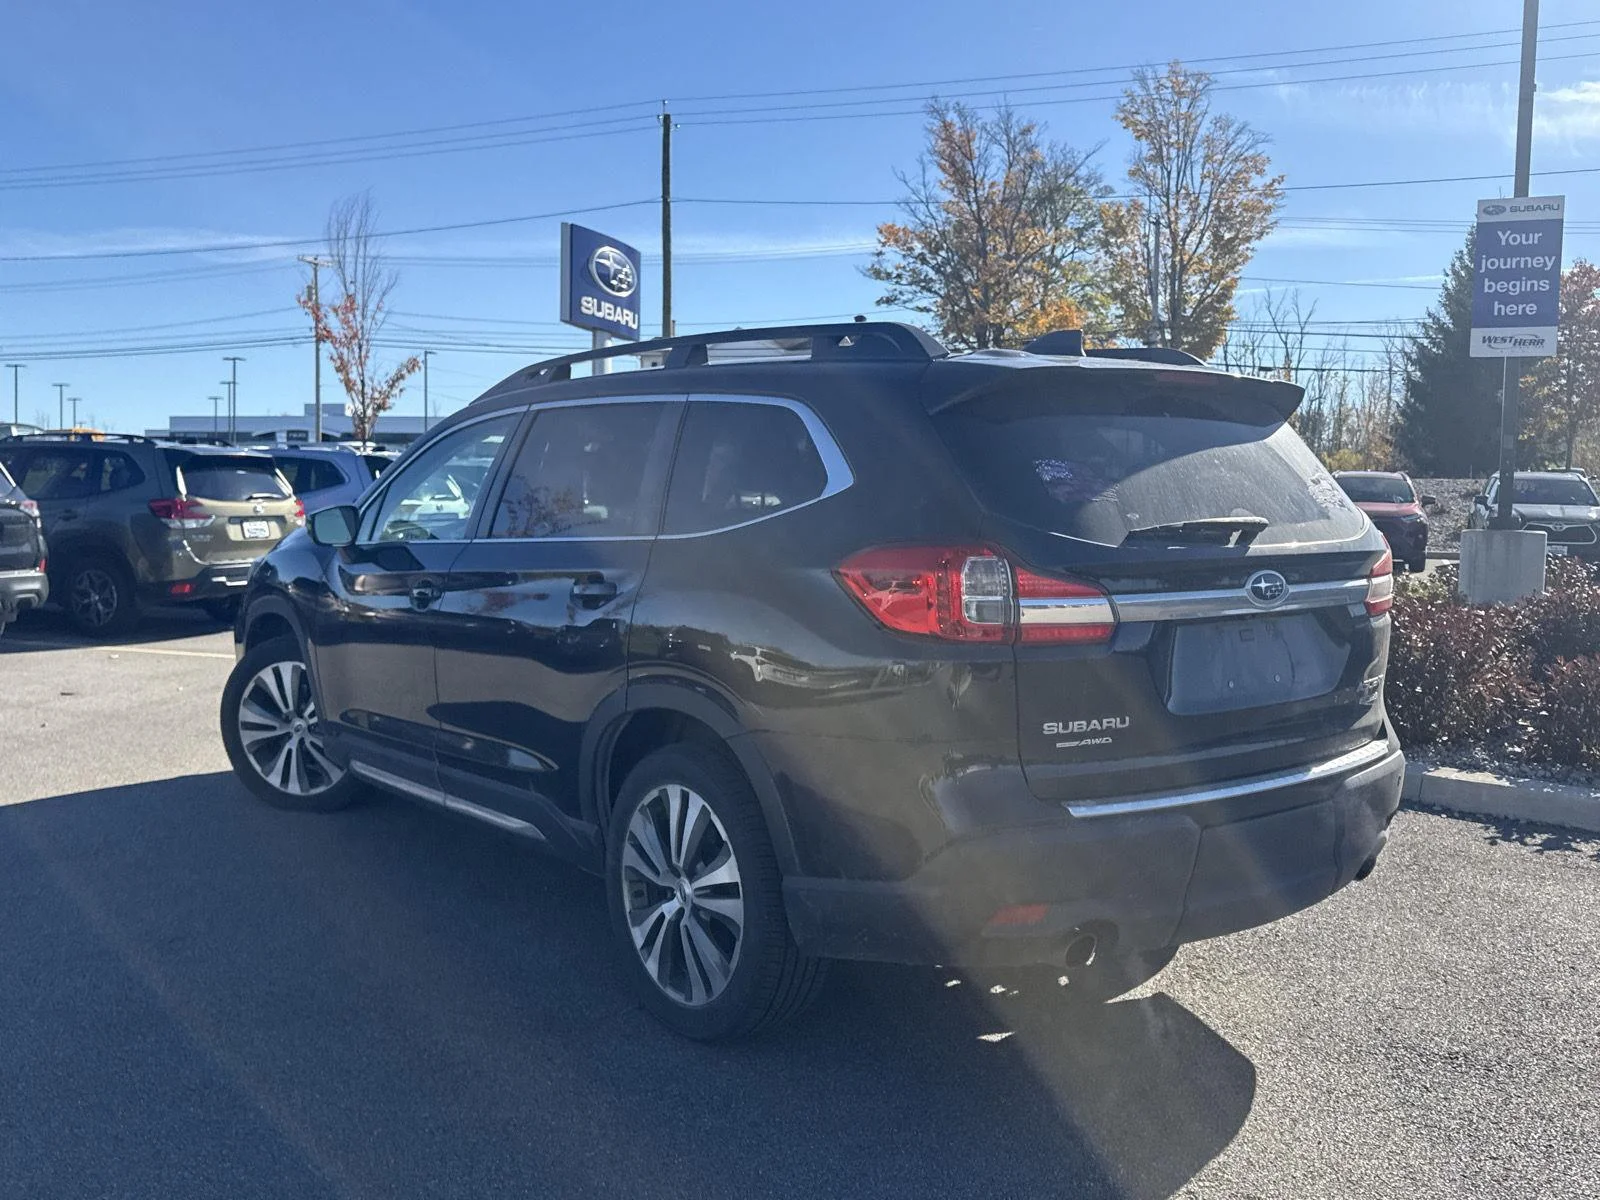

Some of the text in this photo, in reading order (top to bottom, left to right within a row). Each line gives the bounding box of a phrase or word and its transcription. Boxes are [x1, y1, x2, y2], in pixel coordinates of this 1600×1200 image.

[1509, 204, 1560, 213] SUBARU
[1497, 230, 1543, 246] Your
[1479, 255, 1556, 273] journey
[1483, 277, 1550, 295] begins
[580, 296, 638, 329] SUBARU
[1493, 301, 1538, 316] here
[1042, 716, 1130, 735] SUBARU
[1078, 737, 1113, 746] AWD
